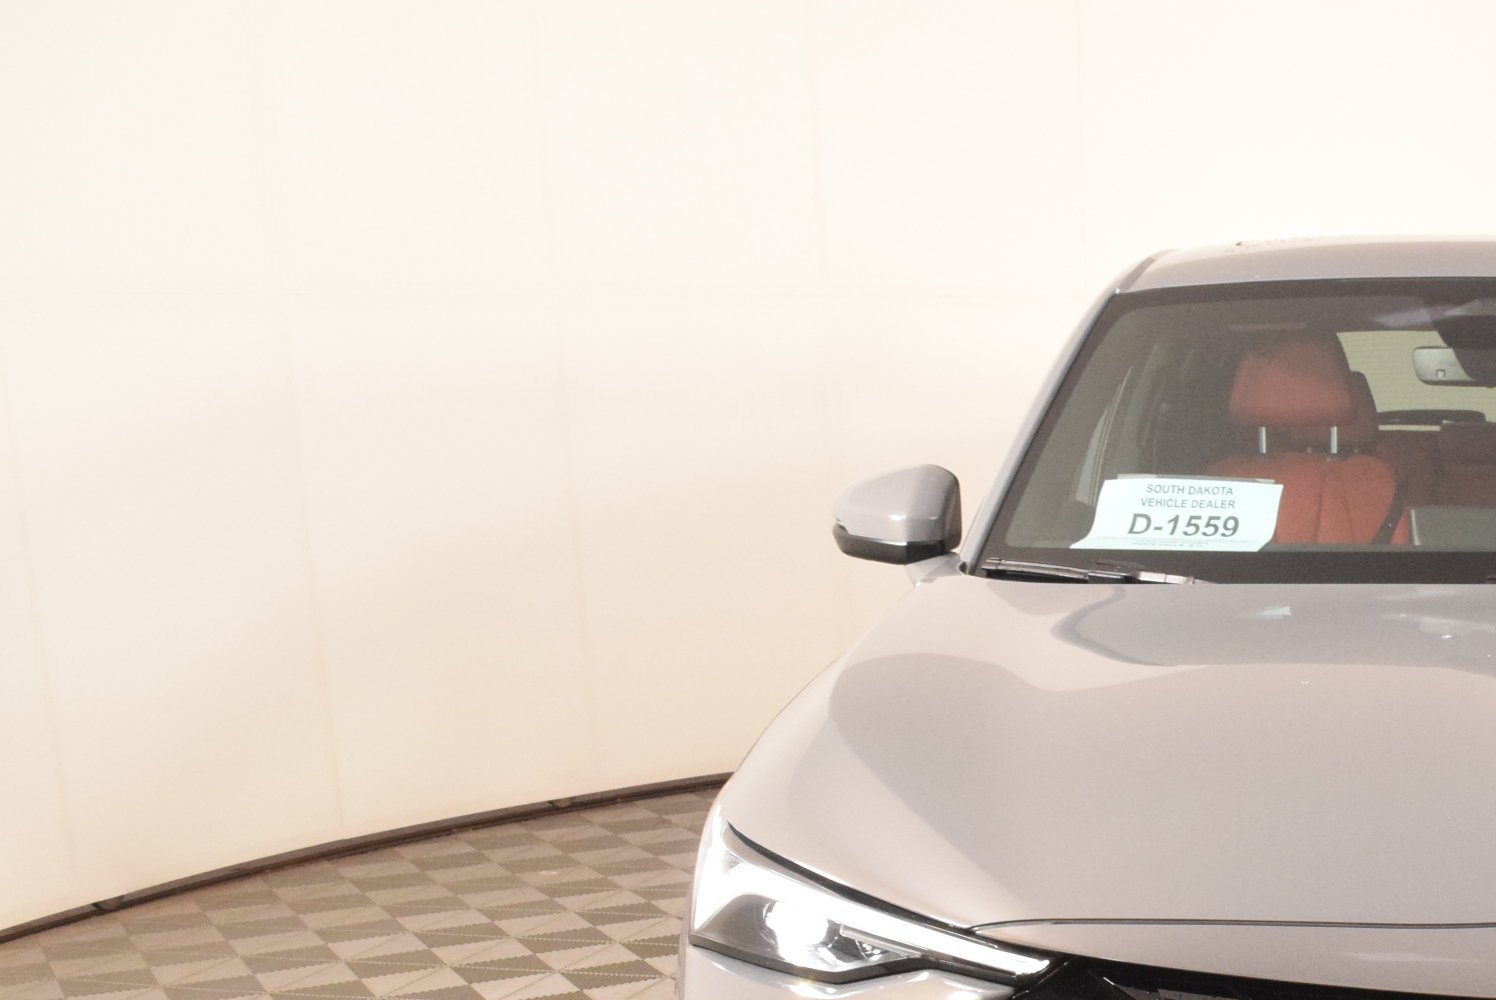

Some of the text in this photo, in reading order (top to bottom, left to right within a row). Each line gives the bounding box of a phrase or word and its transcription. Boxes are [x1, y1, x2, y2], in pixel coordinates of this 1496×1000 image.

[1146, 483, 1234, 496] SOUTH DAKOTA
[1140, 497, 1236, 510] VEHICLE DEALER
[1127, 513, 1240, 538] D-1559
